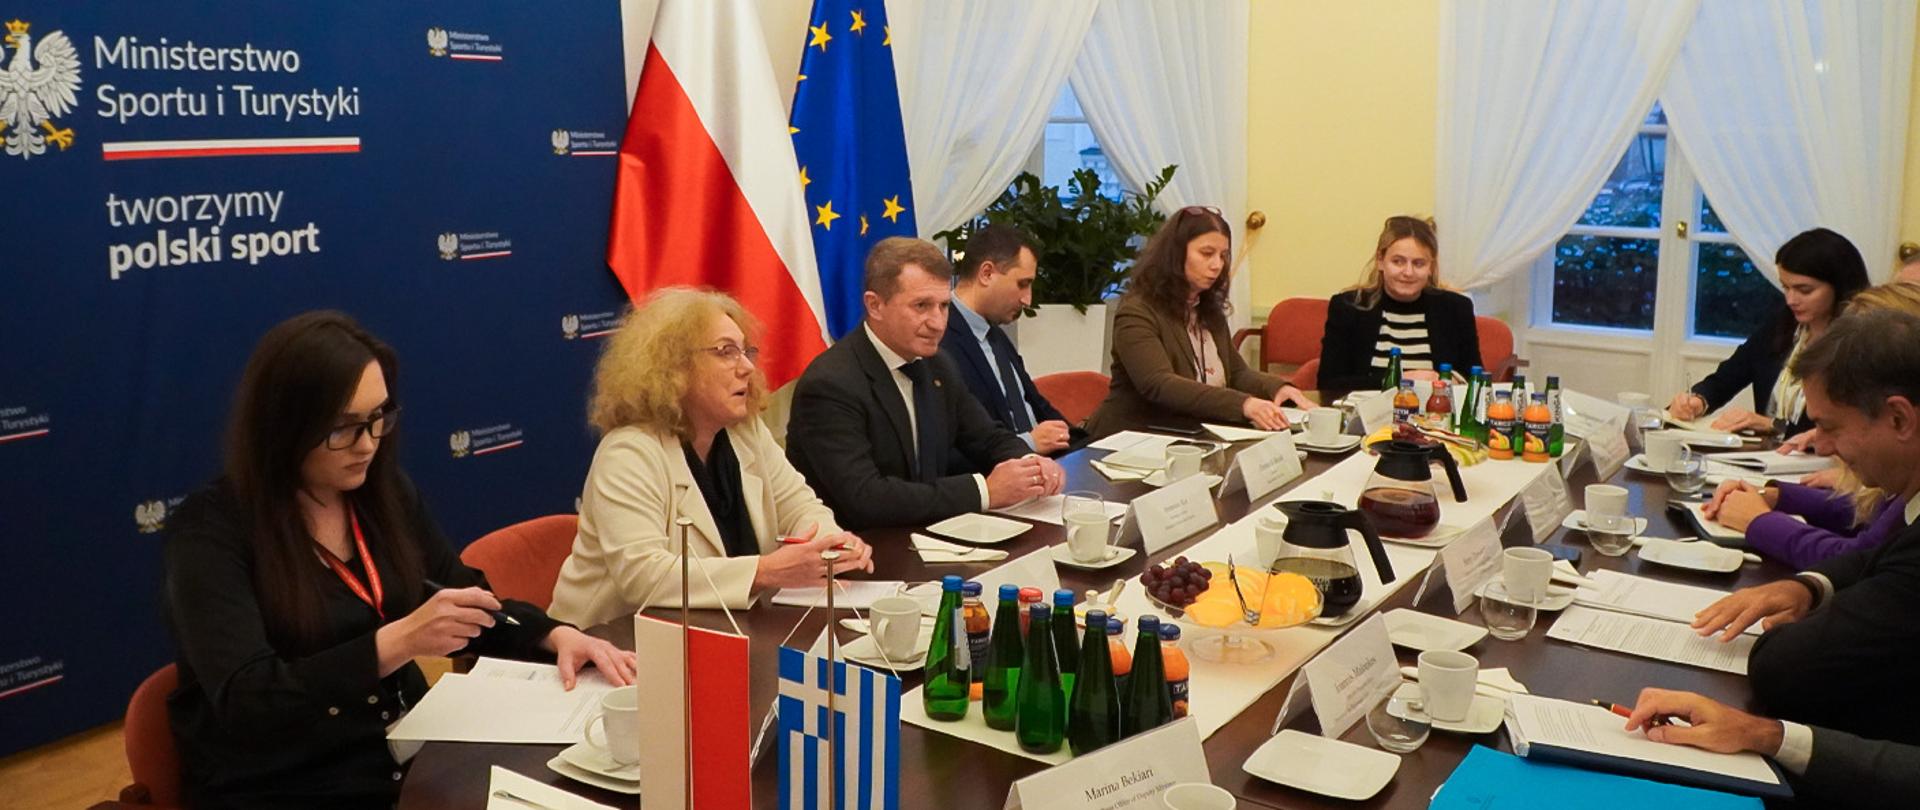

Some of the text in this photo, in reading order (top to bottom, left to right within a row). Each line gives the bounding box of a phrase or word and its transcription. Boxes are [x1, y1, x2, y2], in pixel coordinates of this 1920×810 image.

[94, 35, 300, 72] Ministerstwo
[97, 84, 360, 124] Sportu i Turystyki
[106, 190, 284, 227] tworzymy
[109, 222, 321, 280] polski sport
[1084, 782, 1120, 802] Marina
